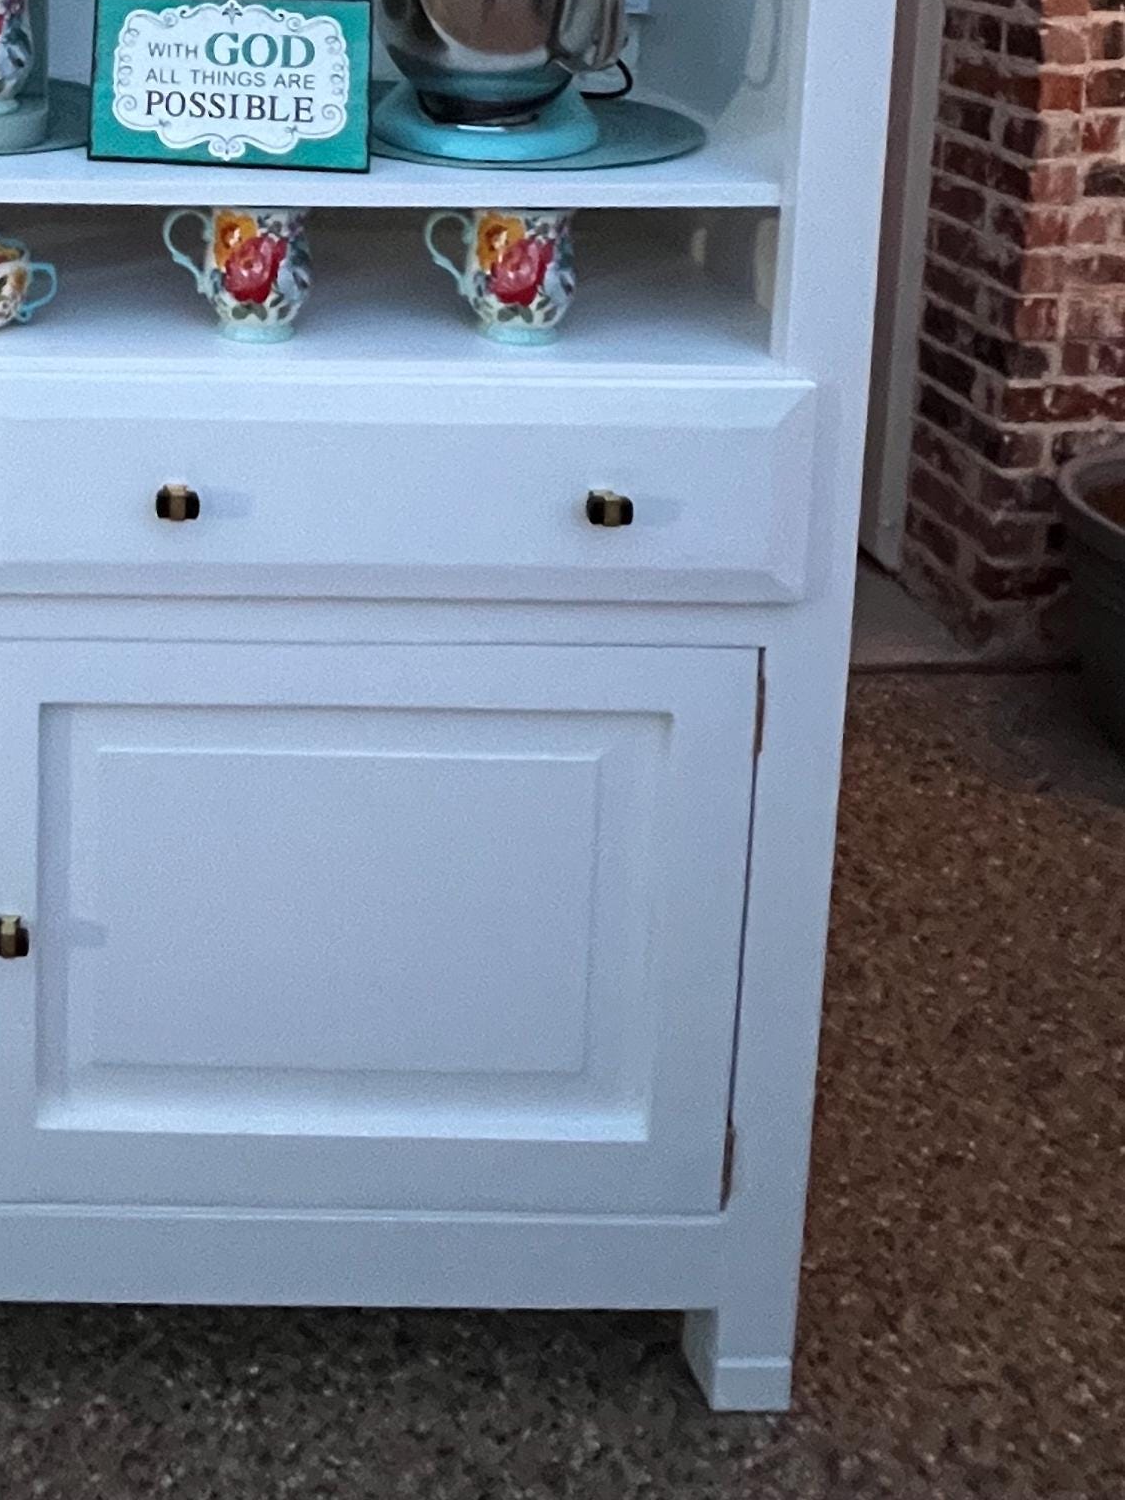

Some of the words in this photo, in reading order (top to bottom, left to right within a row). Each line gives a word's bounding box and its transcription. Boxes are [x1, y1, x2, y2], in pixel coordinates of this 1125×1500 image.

[148, 41, 198, 59] WITH
[205, 31, 316, 69] GOD
[145, 67, 181, 85] ALL
[190, 69, 266, 87] THINGS
[274, 73, 316, 90] ARE
[145, 90, 314, 123] POSSIBLE
